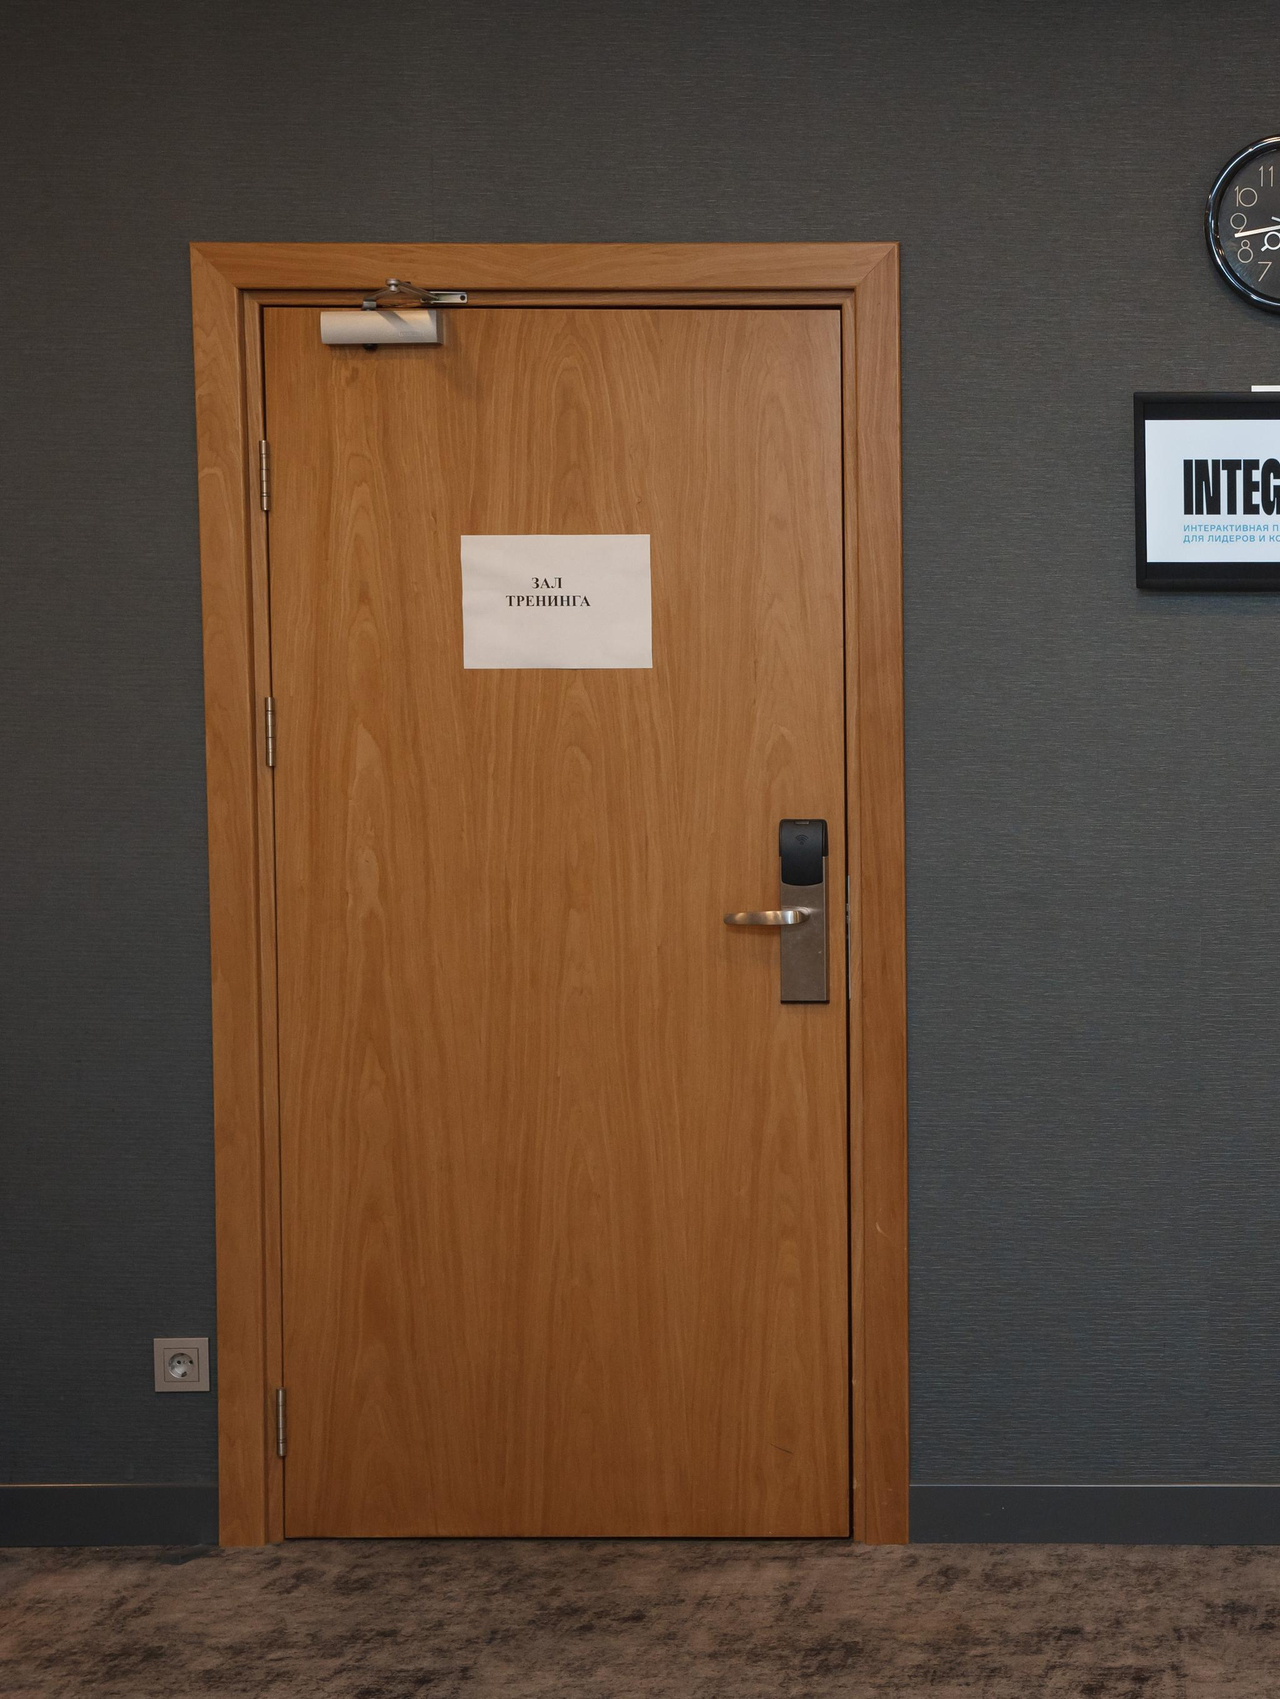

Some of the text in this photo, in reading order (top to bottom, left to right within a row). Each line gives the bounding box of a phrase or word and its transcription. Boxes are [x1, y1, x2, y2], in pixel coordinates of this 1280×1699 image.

[1258, 165, 1274, 187] 11
[1234, 185, 1258, 207] 10
[1230, 212, 1247, 235] 9
[1237, 239, 1254, 264] 8
[1257, 261, 1273, 282] 7
[1183, 524, 1269, 532] ИНТЕРАКТИВНАЯ
[1183, 534, 1204, 544] ДЛЯ
[1207, 534, 1256, 544] ЛИДЕРОВ
[531, 577, 563, 589] ЗАЛ
[505, 595, 591, 607] ТРЕНИНГА
